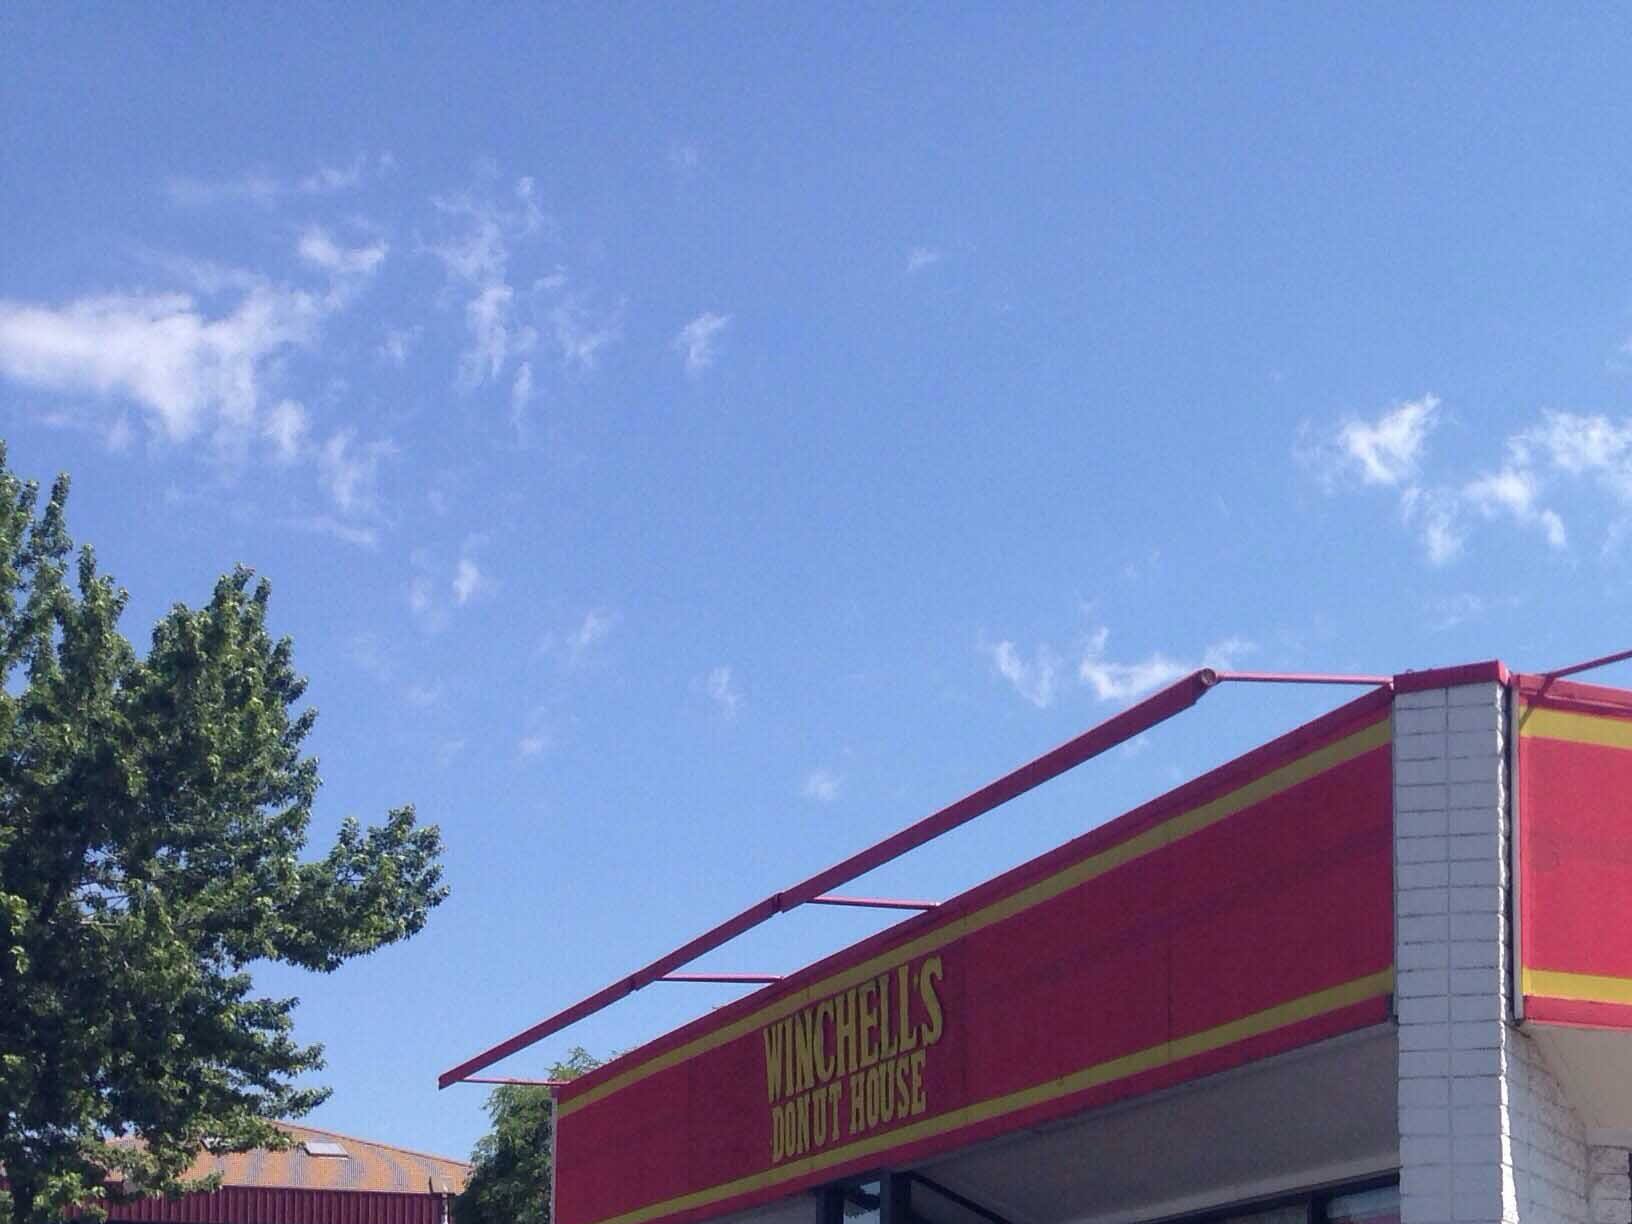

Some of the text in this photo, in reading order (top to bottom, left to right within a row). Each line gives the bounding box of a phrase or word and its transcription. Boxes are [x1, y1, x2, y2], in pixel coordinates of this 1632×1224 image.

[763, 956, 944, 1104] WINCHELL'S
[770, 1048, 926, 1163] DONUT HOUSE
